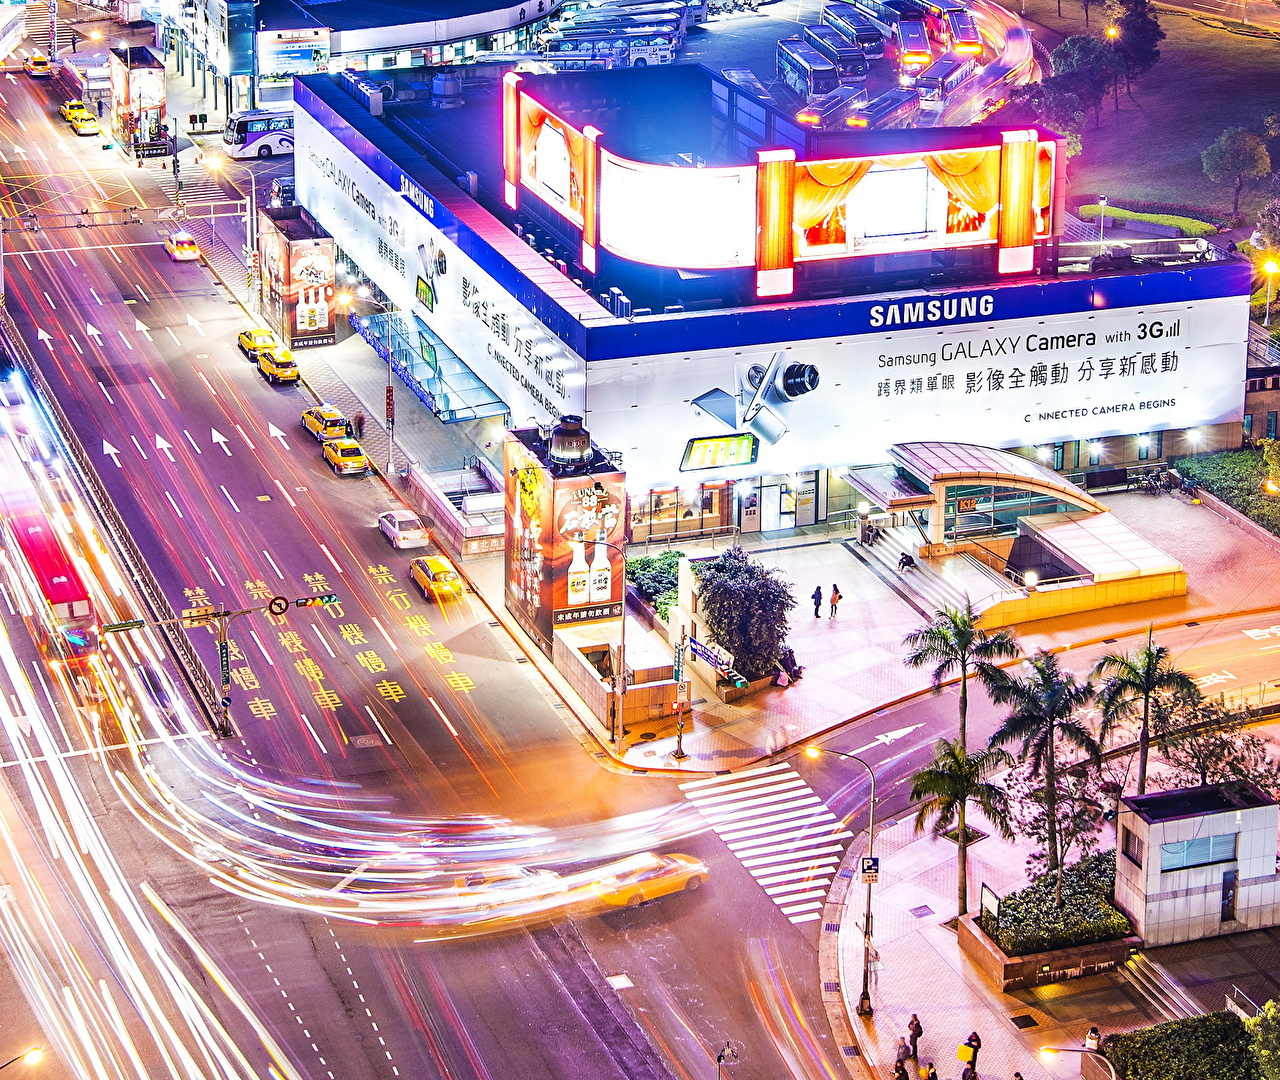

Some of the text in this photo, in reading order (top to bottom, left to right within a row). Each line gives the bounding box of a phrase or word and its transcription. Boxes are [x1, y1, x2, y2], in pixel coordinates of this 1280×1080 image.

[326, 157, 351, 197] GALAXY
[351, 182, 376, 221] Camera
[400, 174, 435, 218] SAMSUNG
[870, 295, 994, 327] SAMSUNG
[878, 321, 1164, 369] Samsung GALAXY Camera with 3G
[520, 371, 544, 407] CAMERA
[877, 351, 1179, 398] 跨界類單眼 影像全觸動 分享新感動
[1092, 403, 1135, 416] CAMERA
[1139, 398, 1176, 410] BEGINS
[960, 499, 976, 509] K12
[303, 571, 407, 703] 禁行機慢車
[366, 564, 477, 695] 禁行機慢車
[557, 607, 610, 622] 未成年請勿飲酒
[183, 586, 277, 721] 禁機慢車
